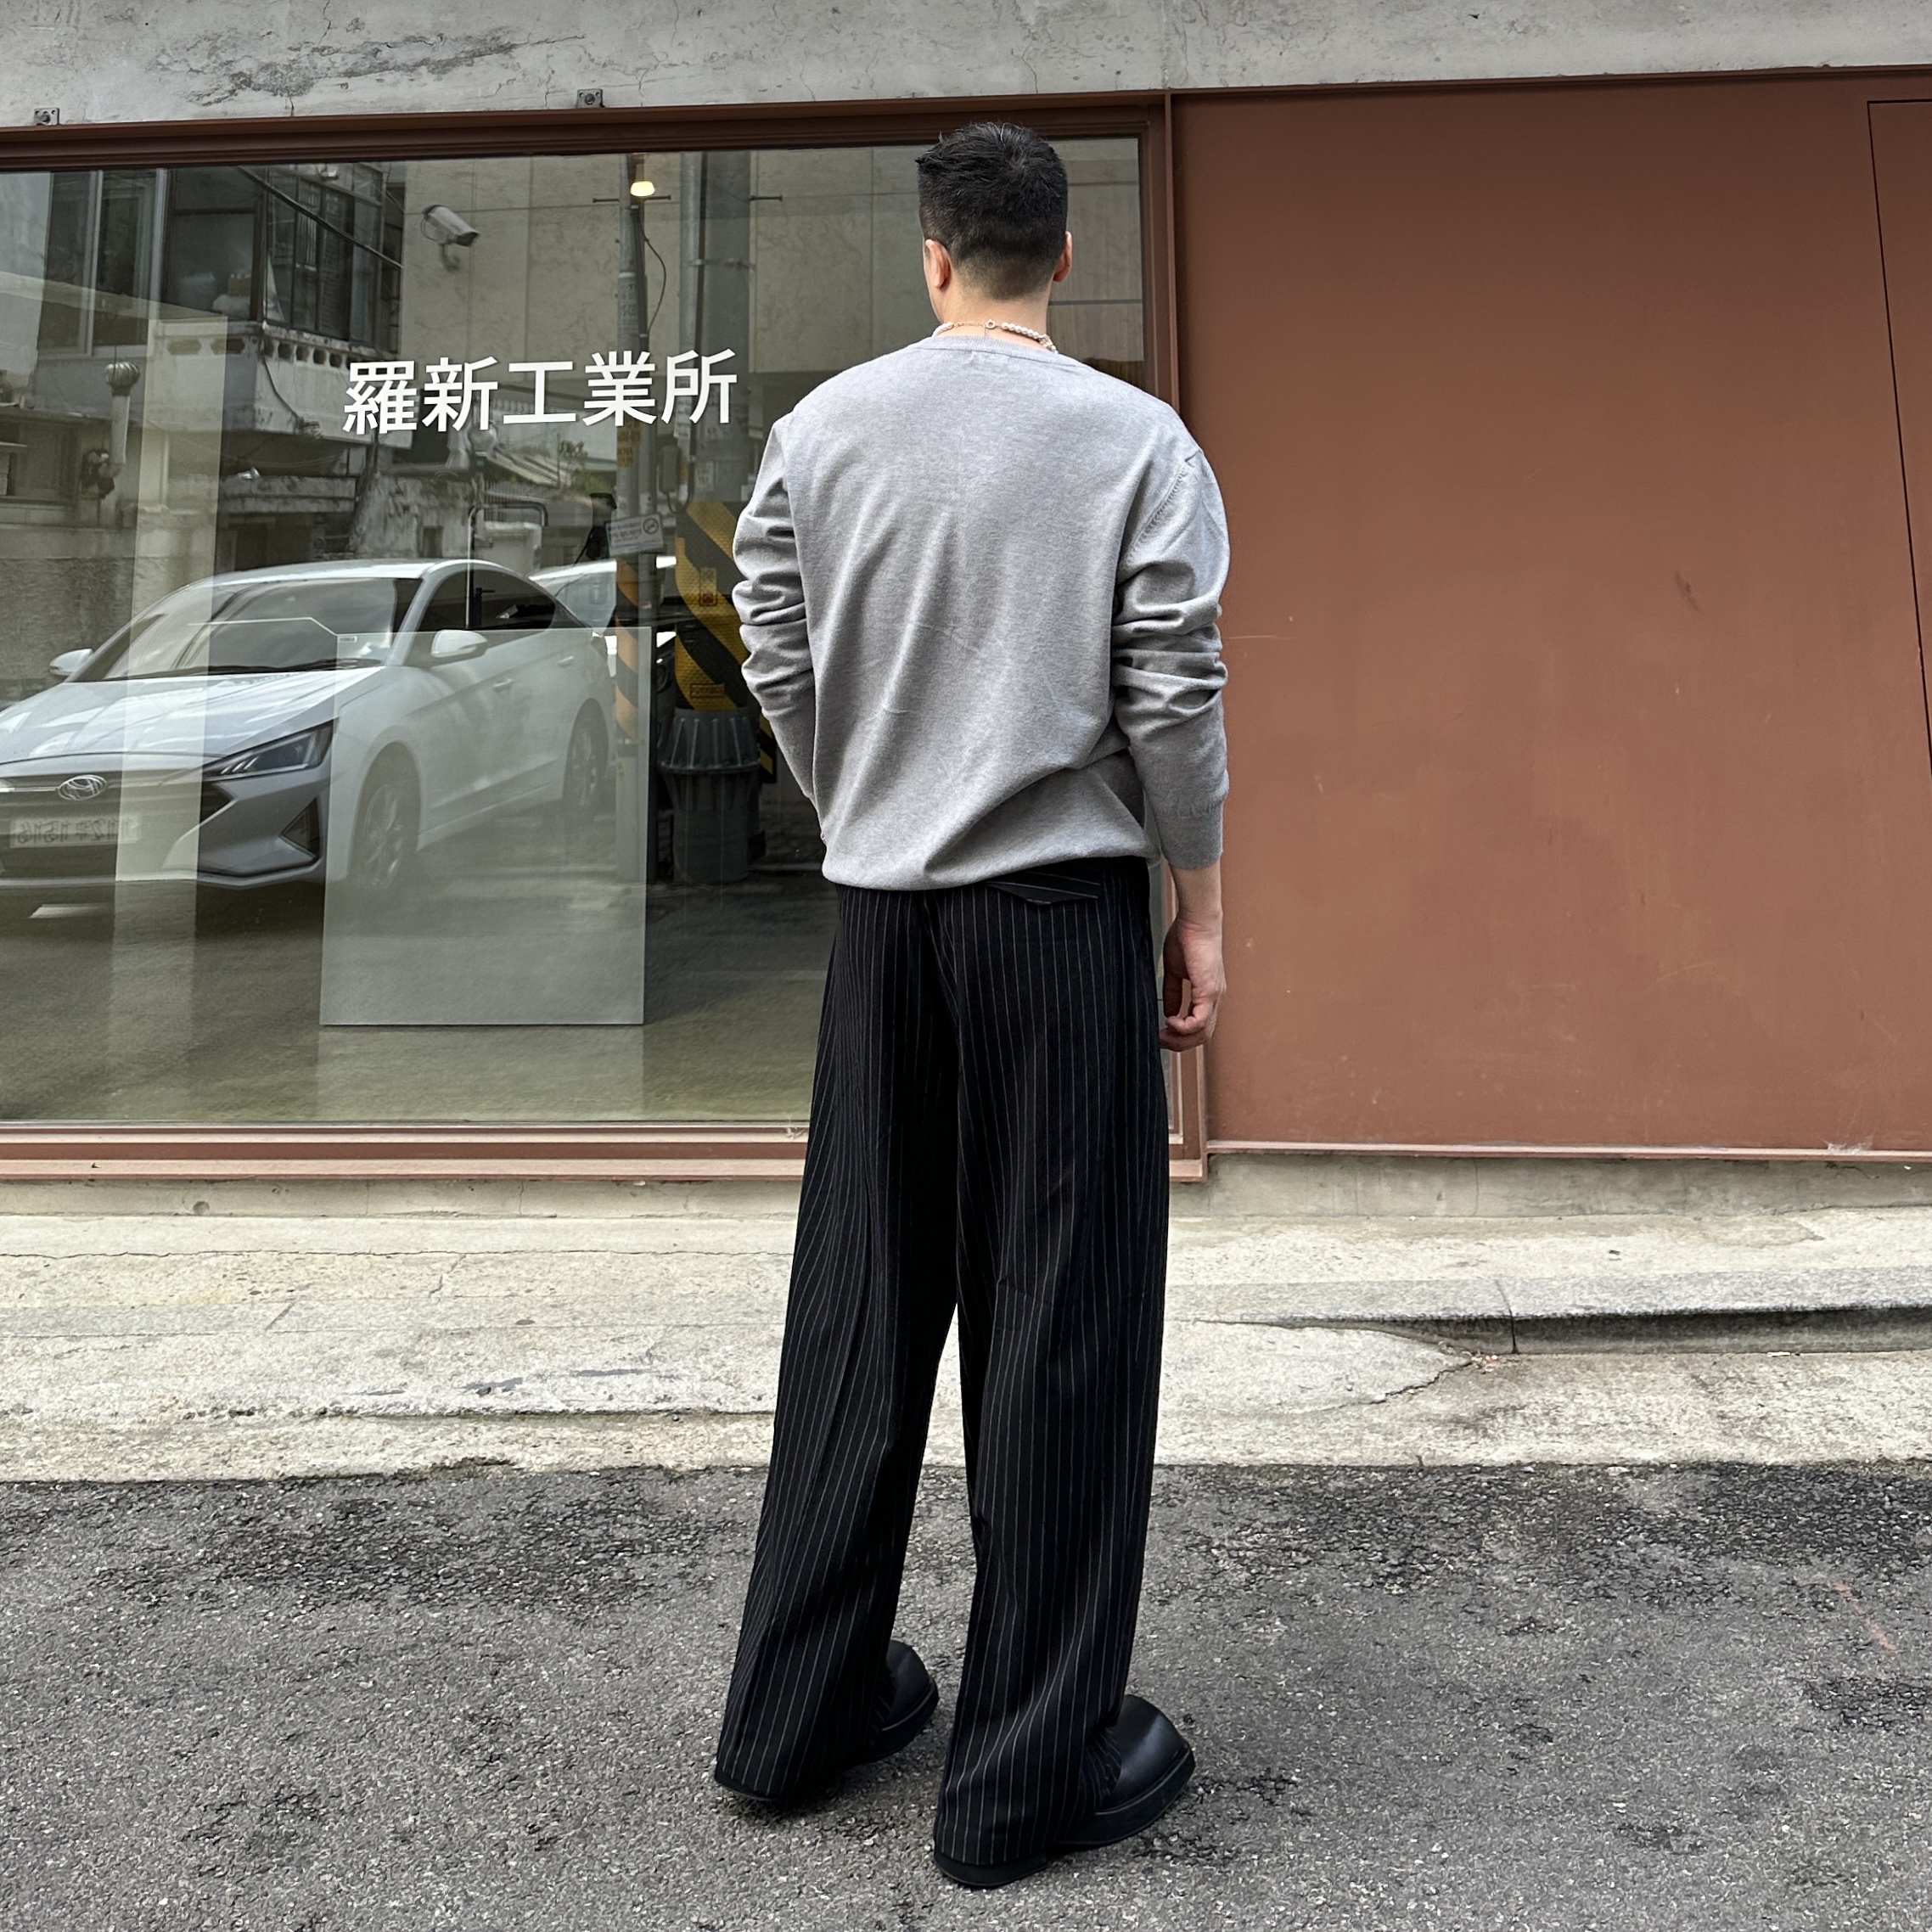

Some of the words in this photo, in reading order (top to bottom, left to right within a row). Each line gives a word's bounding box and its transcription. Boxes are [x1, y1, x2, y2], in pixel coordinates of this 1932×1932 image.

[342, 348, 738, 435] 羅新工業所
